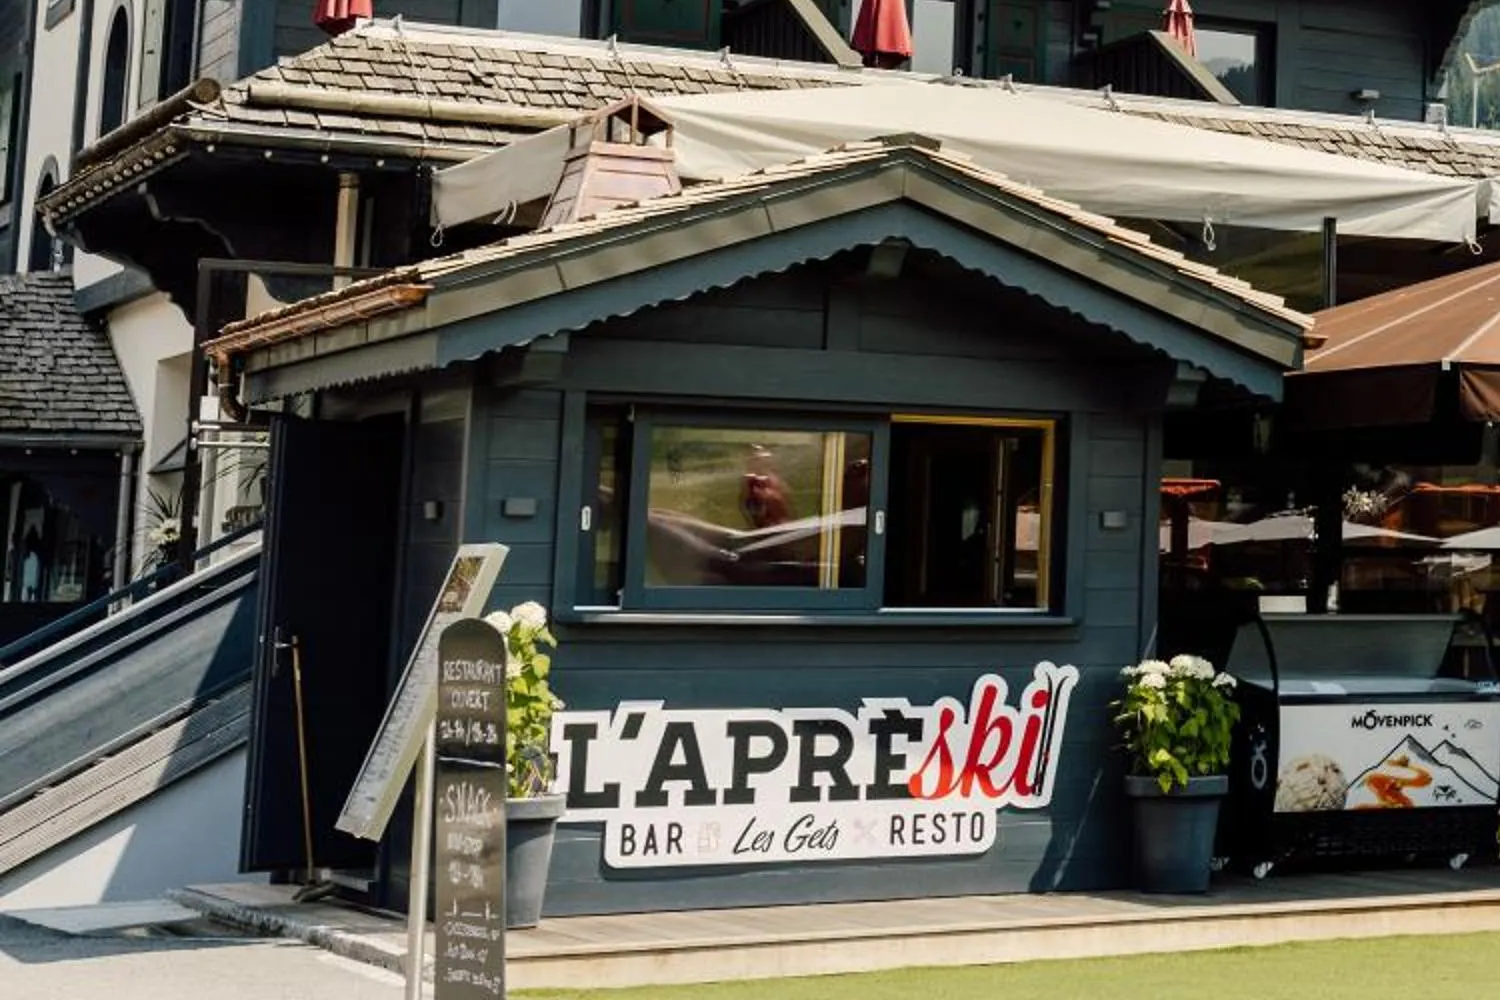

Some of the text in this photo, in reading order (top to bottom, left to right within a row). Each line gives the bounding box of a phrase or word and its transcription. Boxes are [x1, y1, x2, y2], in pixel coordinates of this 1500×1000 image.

[619, 811, 987, 857] BAR Les Gets RESTO
